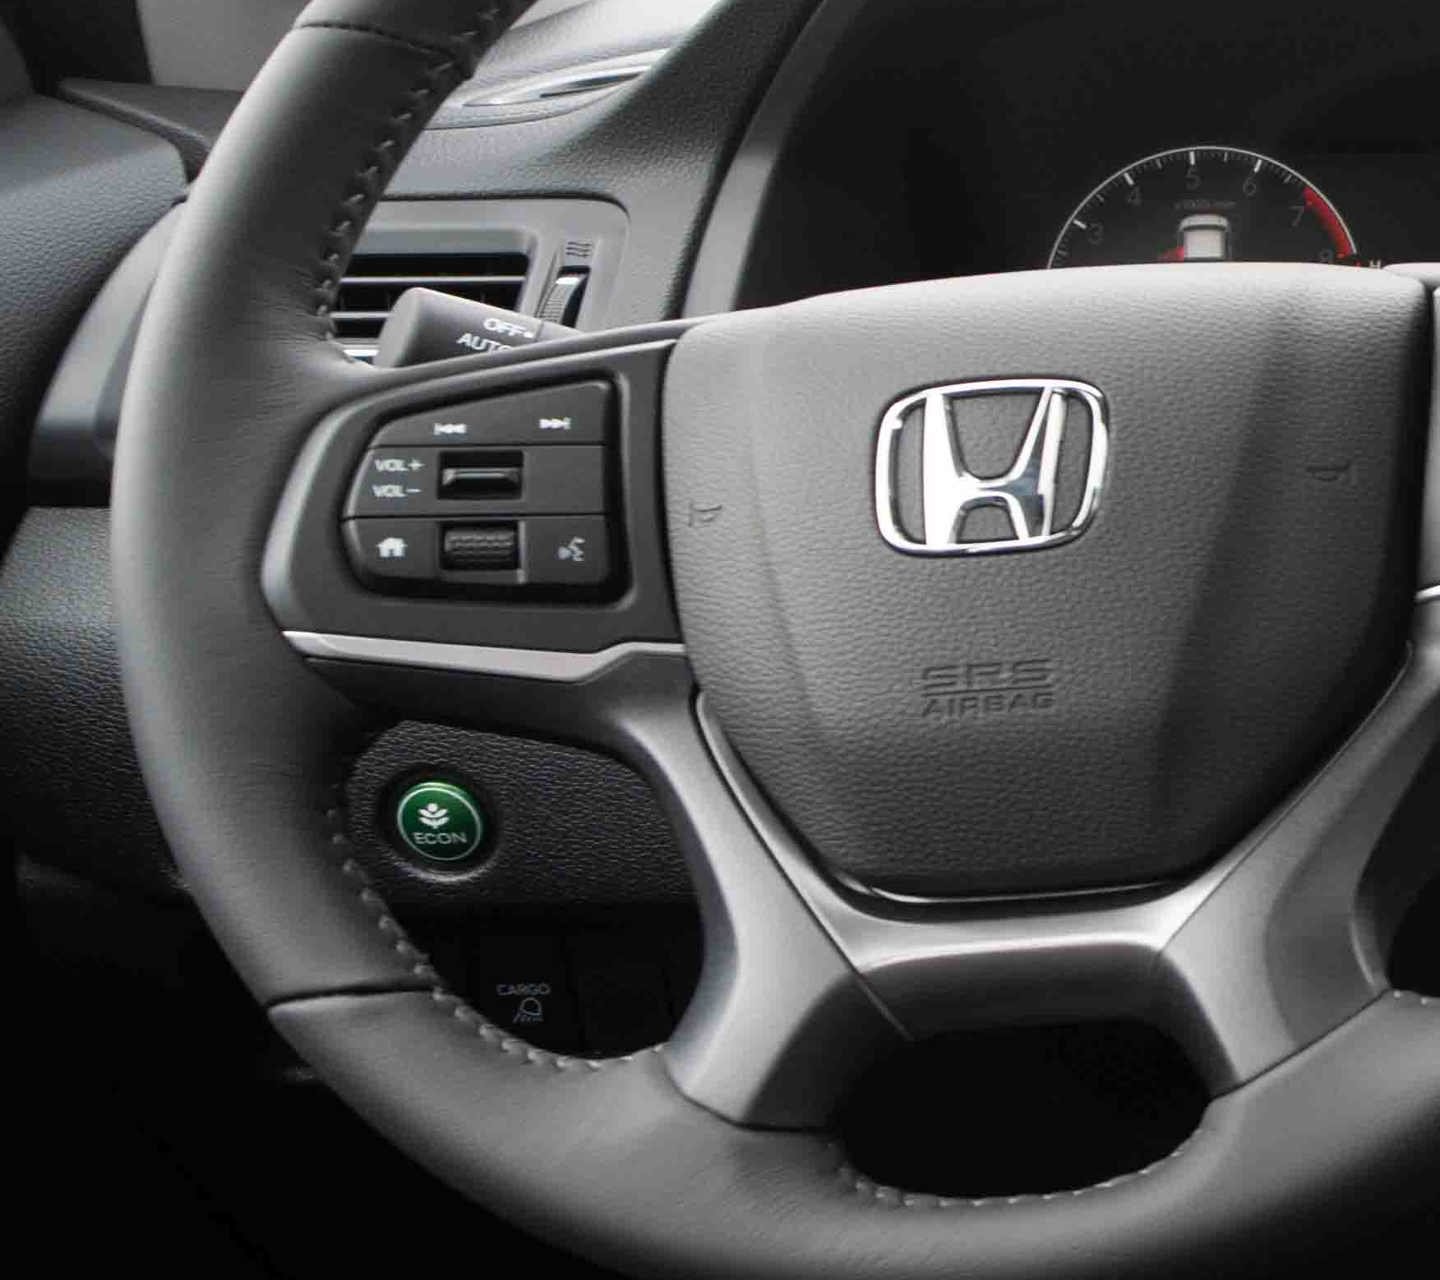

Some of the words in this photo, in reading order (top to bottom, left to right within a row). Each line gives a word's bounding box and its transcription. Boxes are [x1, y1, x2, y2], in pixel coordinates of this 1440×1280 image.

[483, 317, 526, 337] OFF
[921, 693, 1055, 718] AIRBAG
[413, 832, 468, 845] ECON
[496, 983, 550, 996] CARGO
